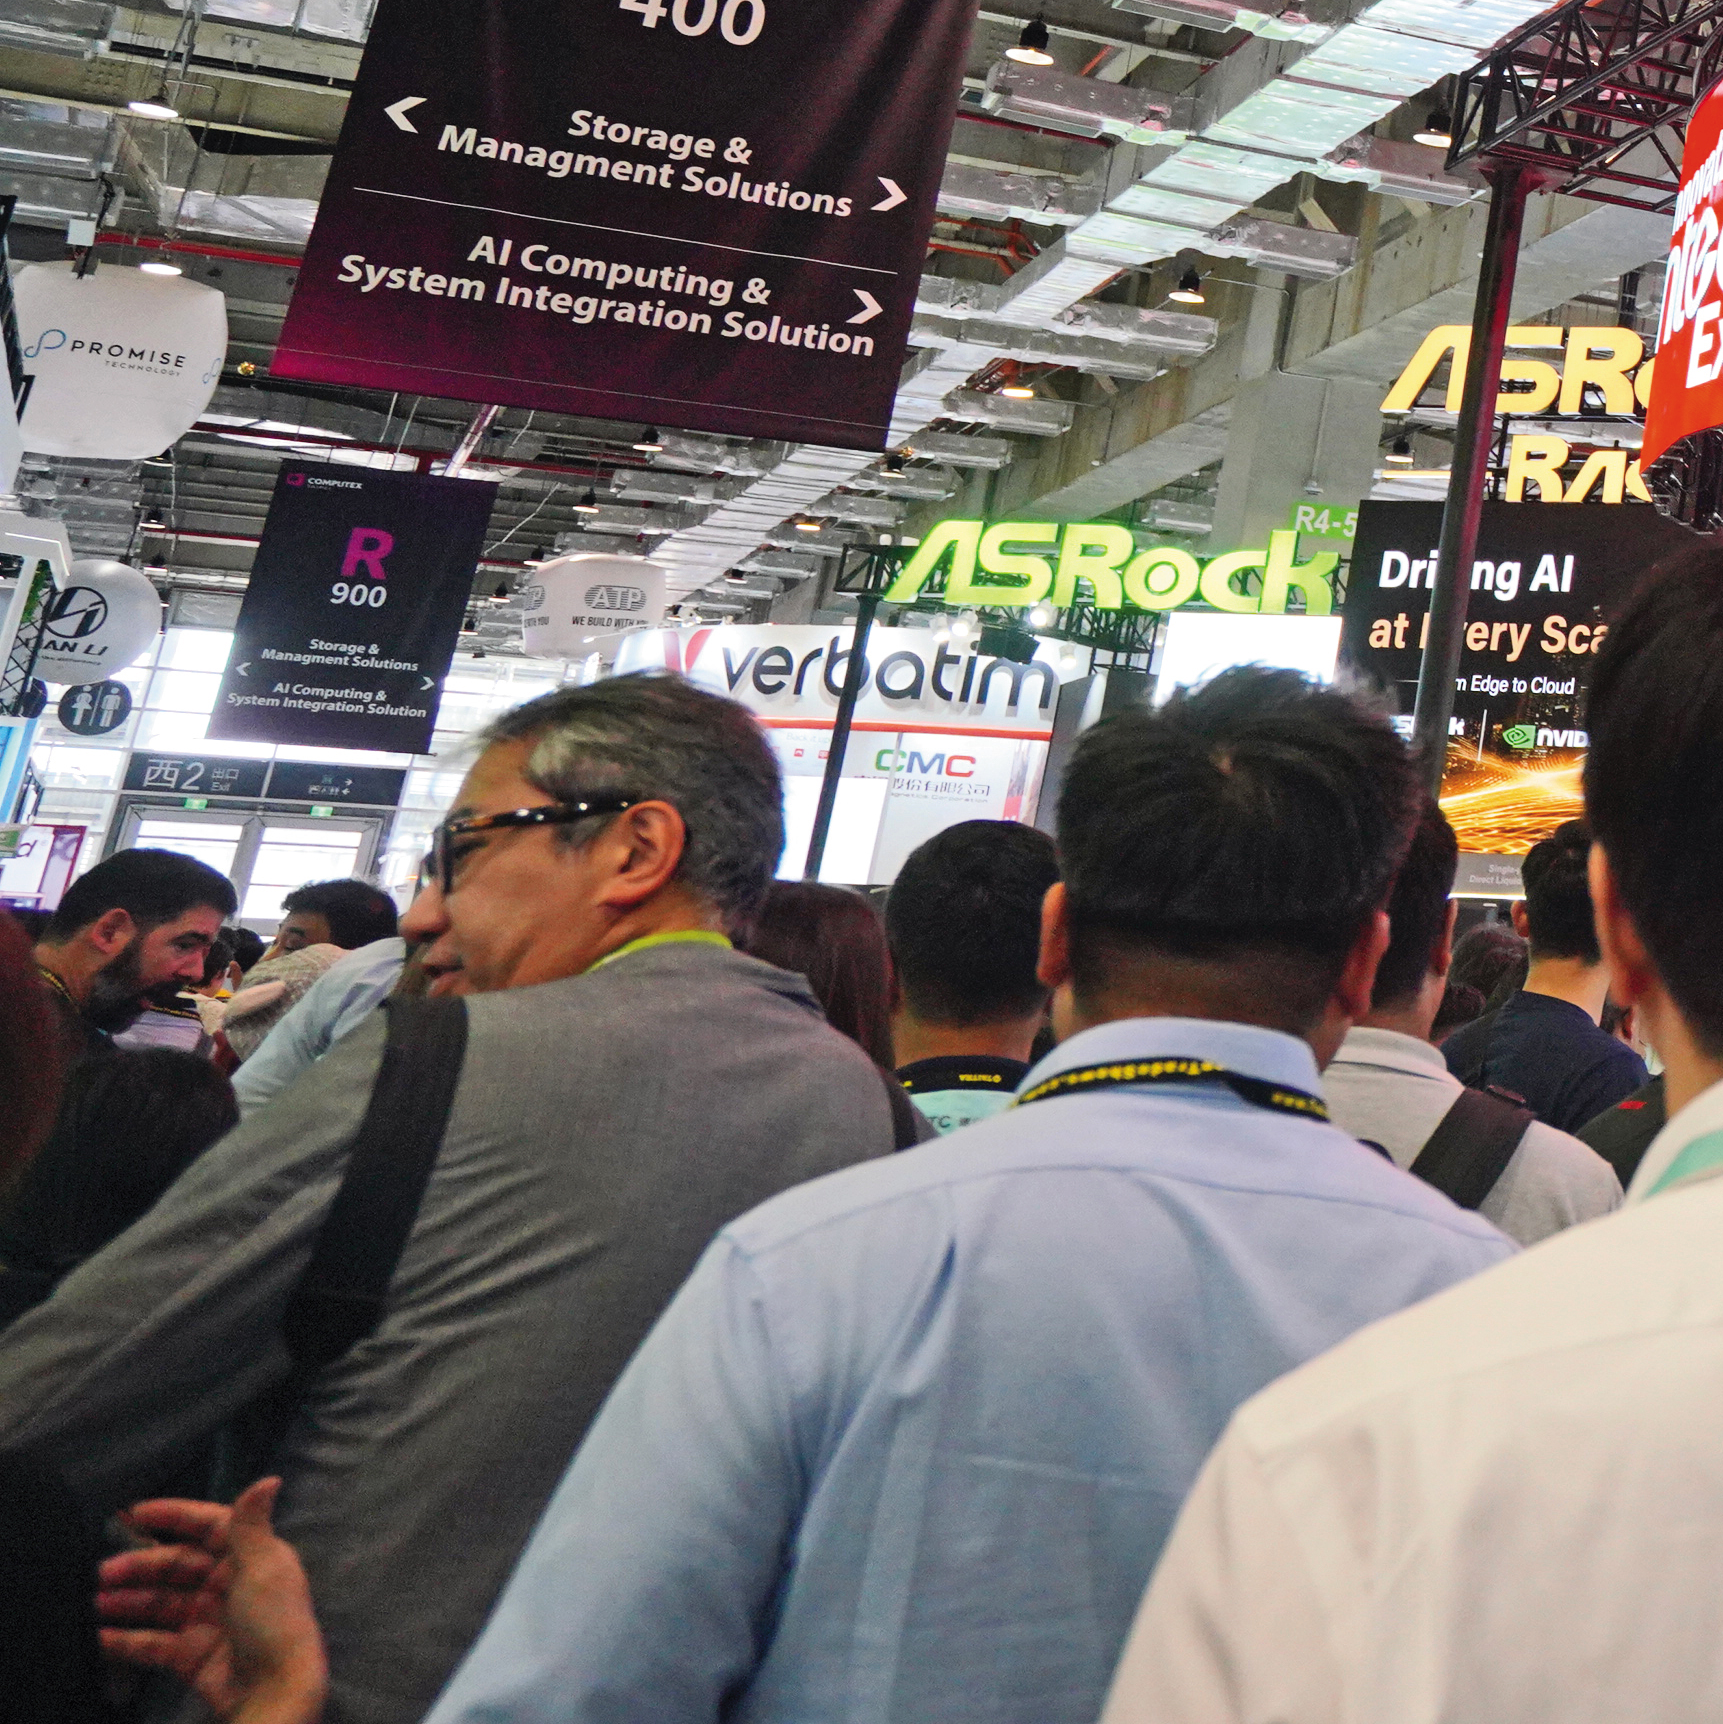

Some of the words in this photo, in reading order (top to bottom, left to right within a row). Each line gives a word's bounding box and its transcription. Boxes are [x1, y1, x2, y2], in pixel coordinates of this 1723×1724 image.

[568, 109, 718, 163] Storage
[722, 136, 754, 165] &
[437, 124, 674, 190] Managment
[679, 165, 853, 219] Solutions
[467, 233, 516, 267] AI
[519, 241, 740, 312] Computing
[744, 277, 770, 307] &
[338, 253, 485, 309] System
[495, 273, 713, 336] Integration
[720, 307, 876, 357] Solution
[71, 339, 187, 368] PROMISE
[104, 360, 181, 377] TECHNOLOGY
[1379, 325, 1655, 415] ASR
[307, 477, 363, 489] COMPUTEX
[341, 527, 394, 580] R
[884, 520, 1342, 616] ASRock
[1378, 550, 1521, 599] Dring
[1530, 555, 1574, 593] AI
[330, 582, 387, 608] 900
[572, 616, 585, 626] WE
[588, 617, 613, 627] BUILD
[614, 618, 633, 627] WITH
[43, 640, 78, 653] AN
[309, 638, 366, 659] Storage
[368, 642, 380, 655] &
[1369, 613, 1409, 649] at
[1421, 620, 1532, 662] ery
[1540, 615, 1608, 656] Sca
[261, 648, 349, 670] Managment
[351, 654, 418, 672] Solutions
[722, 635, 1052, 710] verbatim
[273, 682, 290, 696] AI
[291, 683, 372, 706] Computing
[374, 688, 387, 702] &
[1470, 674, 1510, 696] Edge
[1512, 676, 1528, 694] to
[1530, 676, 1576, 695] Cloud
[227, 692, 280, 711] System
[282, 696, 366, 717] Integration
[366, 702, 427, 719] Solution
[1537, 727, 1590, 748] NVID
[874, 748, 977, 778] CMC
